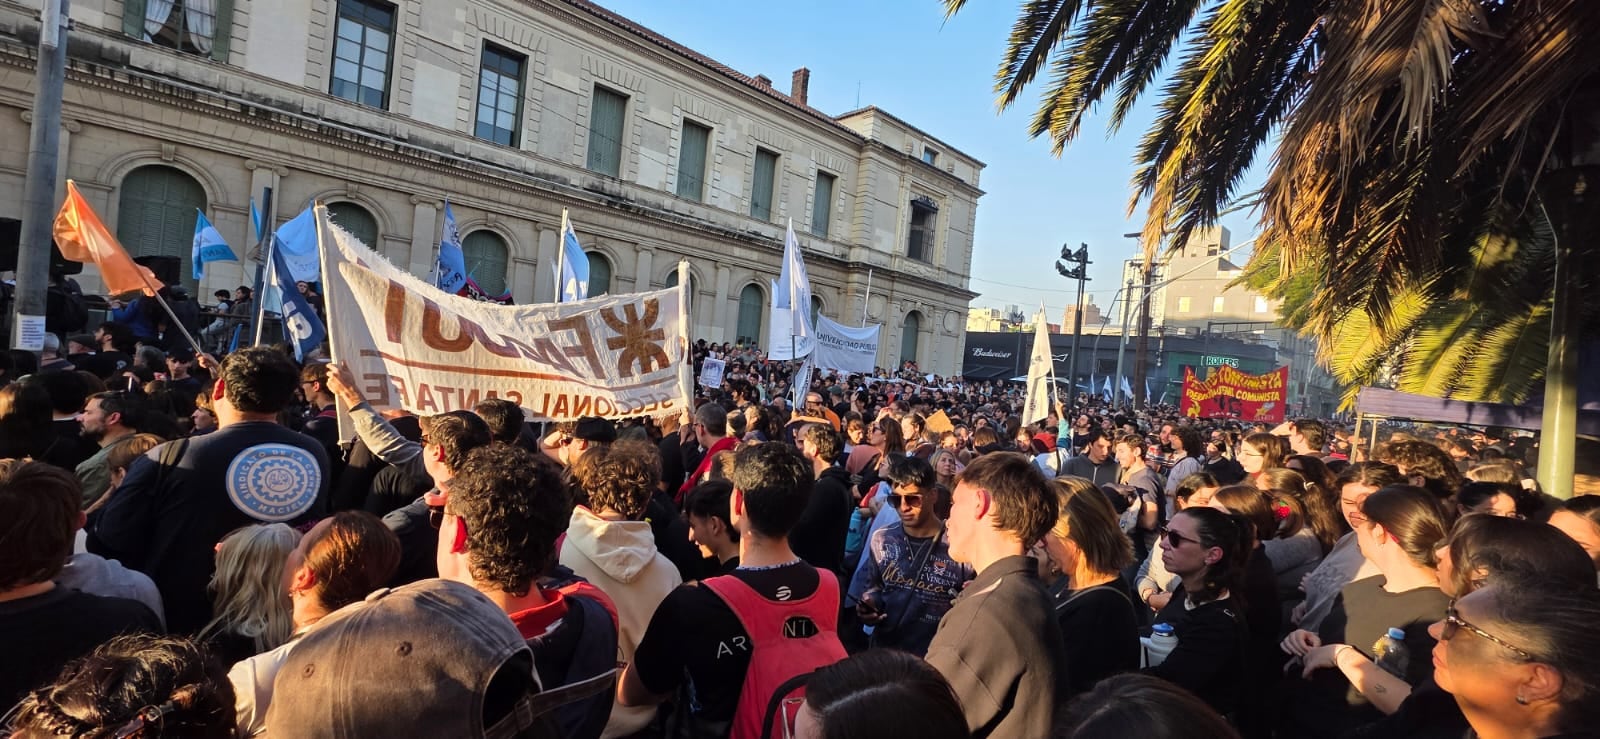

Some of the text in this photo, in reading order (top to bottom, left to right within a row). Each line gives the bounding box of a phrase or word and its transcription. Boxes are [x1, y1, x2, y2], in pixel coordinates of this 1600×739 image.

[972, 347, 1012, 358] Budweiser
[1235, 390, 1281, 402] COMUNISTA
[239, 451, 267, 500] SINDICATO
[291, 453, 304, 462] LA
[258, 501, 305, 514] MACIEL
